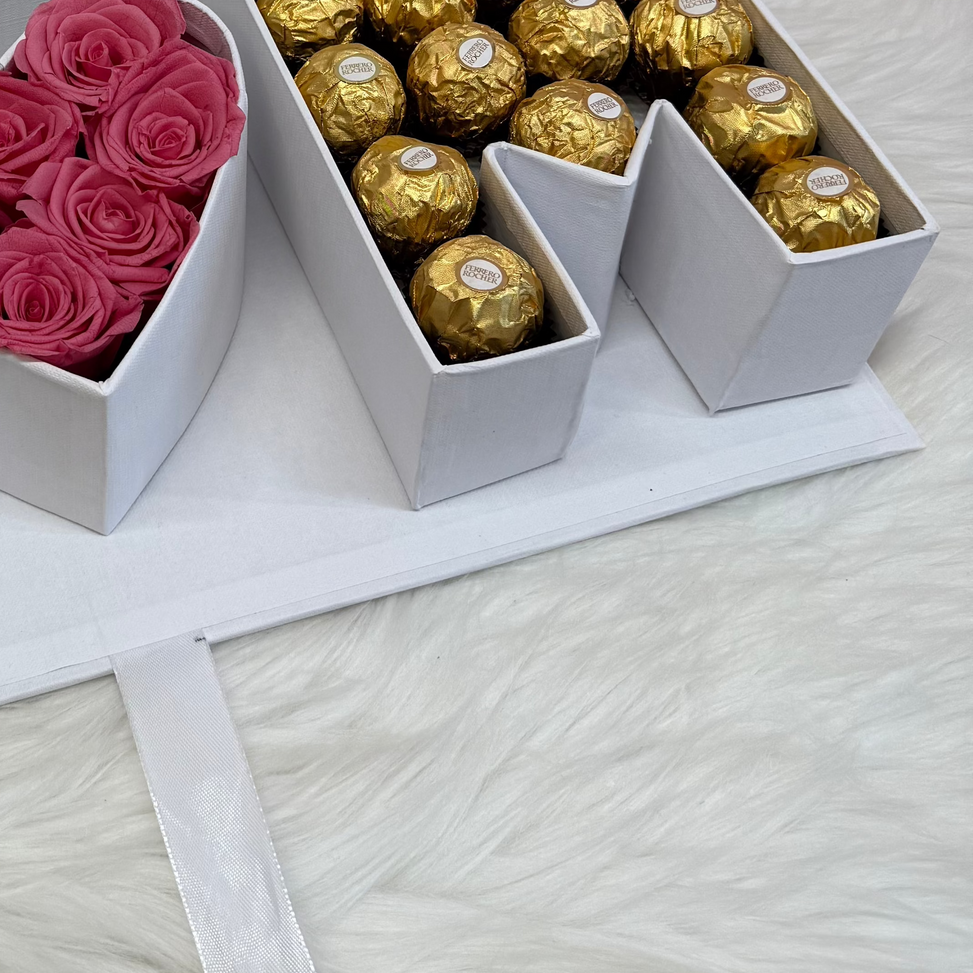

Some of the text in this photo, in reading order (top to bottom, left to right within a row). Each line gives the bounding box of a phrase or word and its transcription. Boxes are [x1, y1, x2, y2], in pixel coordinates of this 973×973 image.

[461, 38, 484, 62] FERRERO
[467, 41, 490, 66] ROCHER
[340, 62, 373, 70] FERRERO
[341, 66, 374, 75] ROCHER
[748, 80, 780, 94] FERRERO
[753, 85, 785, 98] ROCHER
[589, 96, 613, 109] FERRERO
[594, 101, 619, 114] ROCHER
[404, 147, 429, 166] FERRERO
[409, 152, 434, 168] ROCHER
[809, 173, 845, 185] ROCHER
[811, 177, 847, 191] FERRERO
[462, 270, 498, 285] ROCHER
[464, 264, 501, 279] FERRERO
